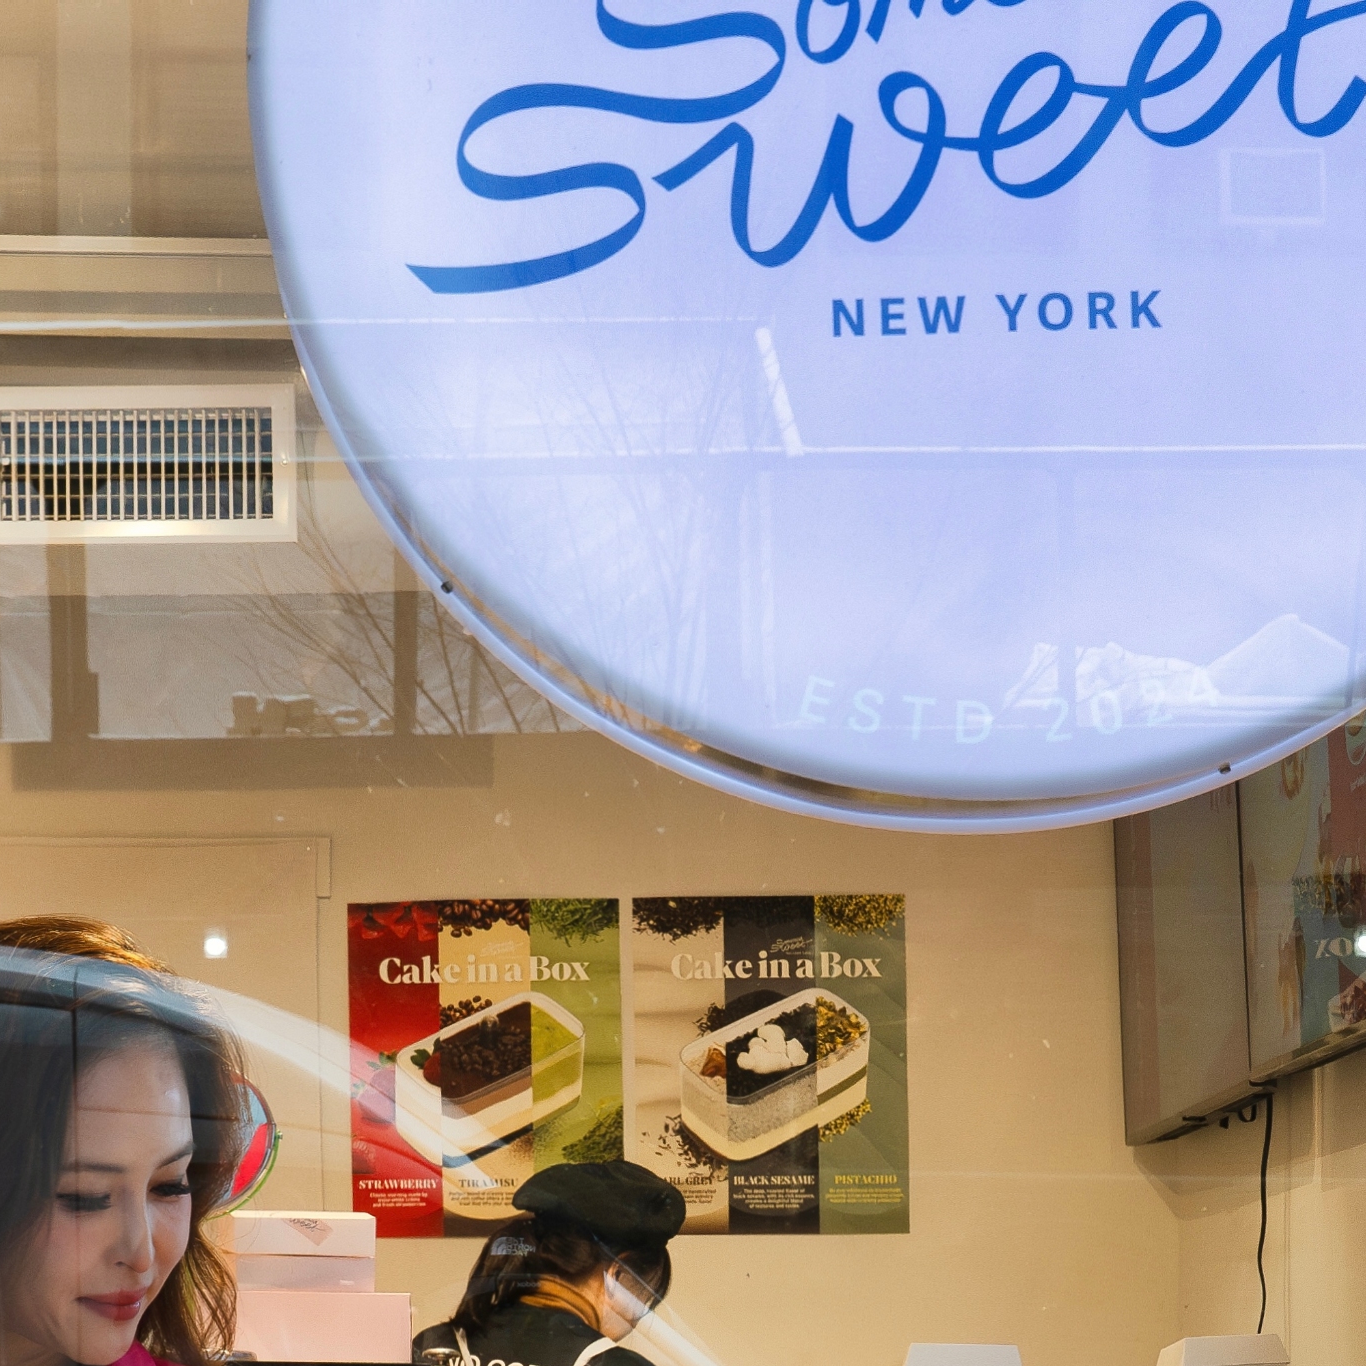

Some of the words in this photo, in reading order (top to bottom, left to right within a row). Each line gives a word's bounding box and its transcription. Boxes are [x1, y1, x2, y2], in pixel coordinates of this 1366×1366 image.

[832, 295, 966, 338] NEW
[996, 289, 1163, 333] YORK
[798, 675, 993, 744] ESTD
[1046, 667, 1220, 742] 2024
[379, 956, 462, 984] Cake
[466, 954, 497, 983] in
[505, 963, 523, 983] a
[530, 956, 590, 983] Box
[671, 953, 752, 979] Cake
[758, 951, 791, 979] in
[795, 960, 815, 979] a
[819, 951, 882, 979] Box
[359, 1178, 438, 1190] STRAWBERRY
[458, 1179, 518, 1189] TIRAMISU
[733, 1176, 769, 1185] BLACK
[771, 1175, 815, 1185] SESAME
[834, 1175, 897, 1185] PISTACHIO
